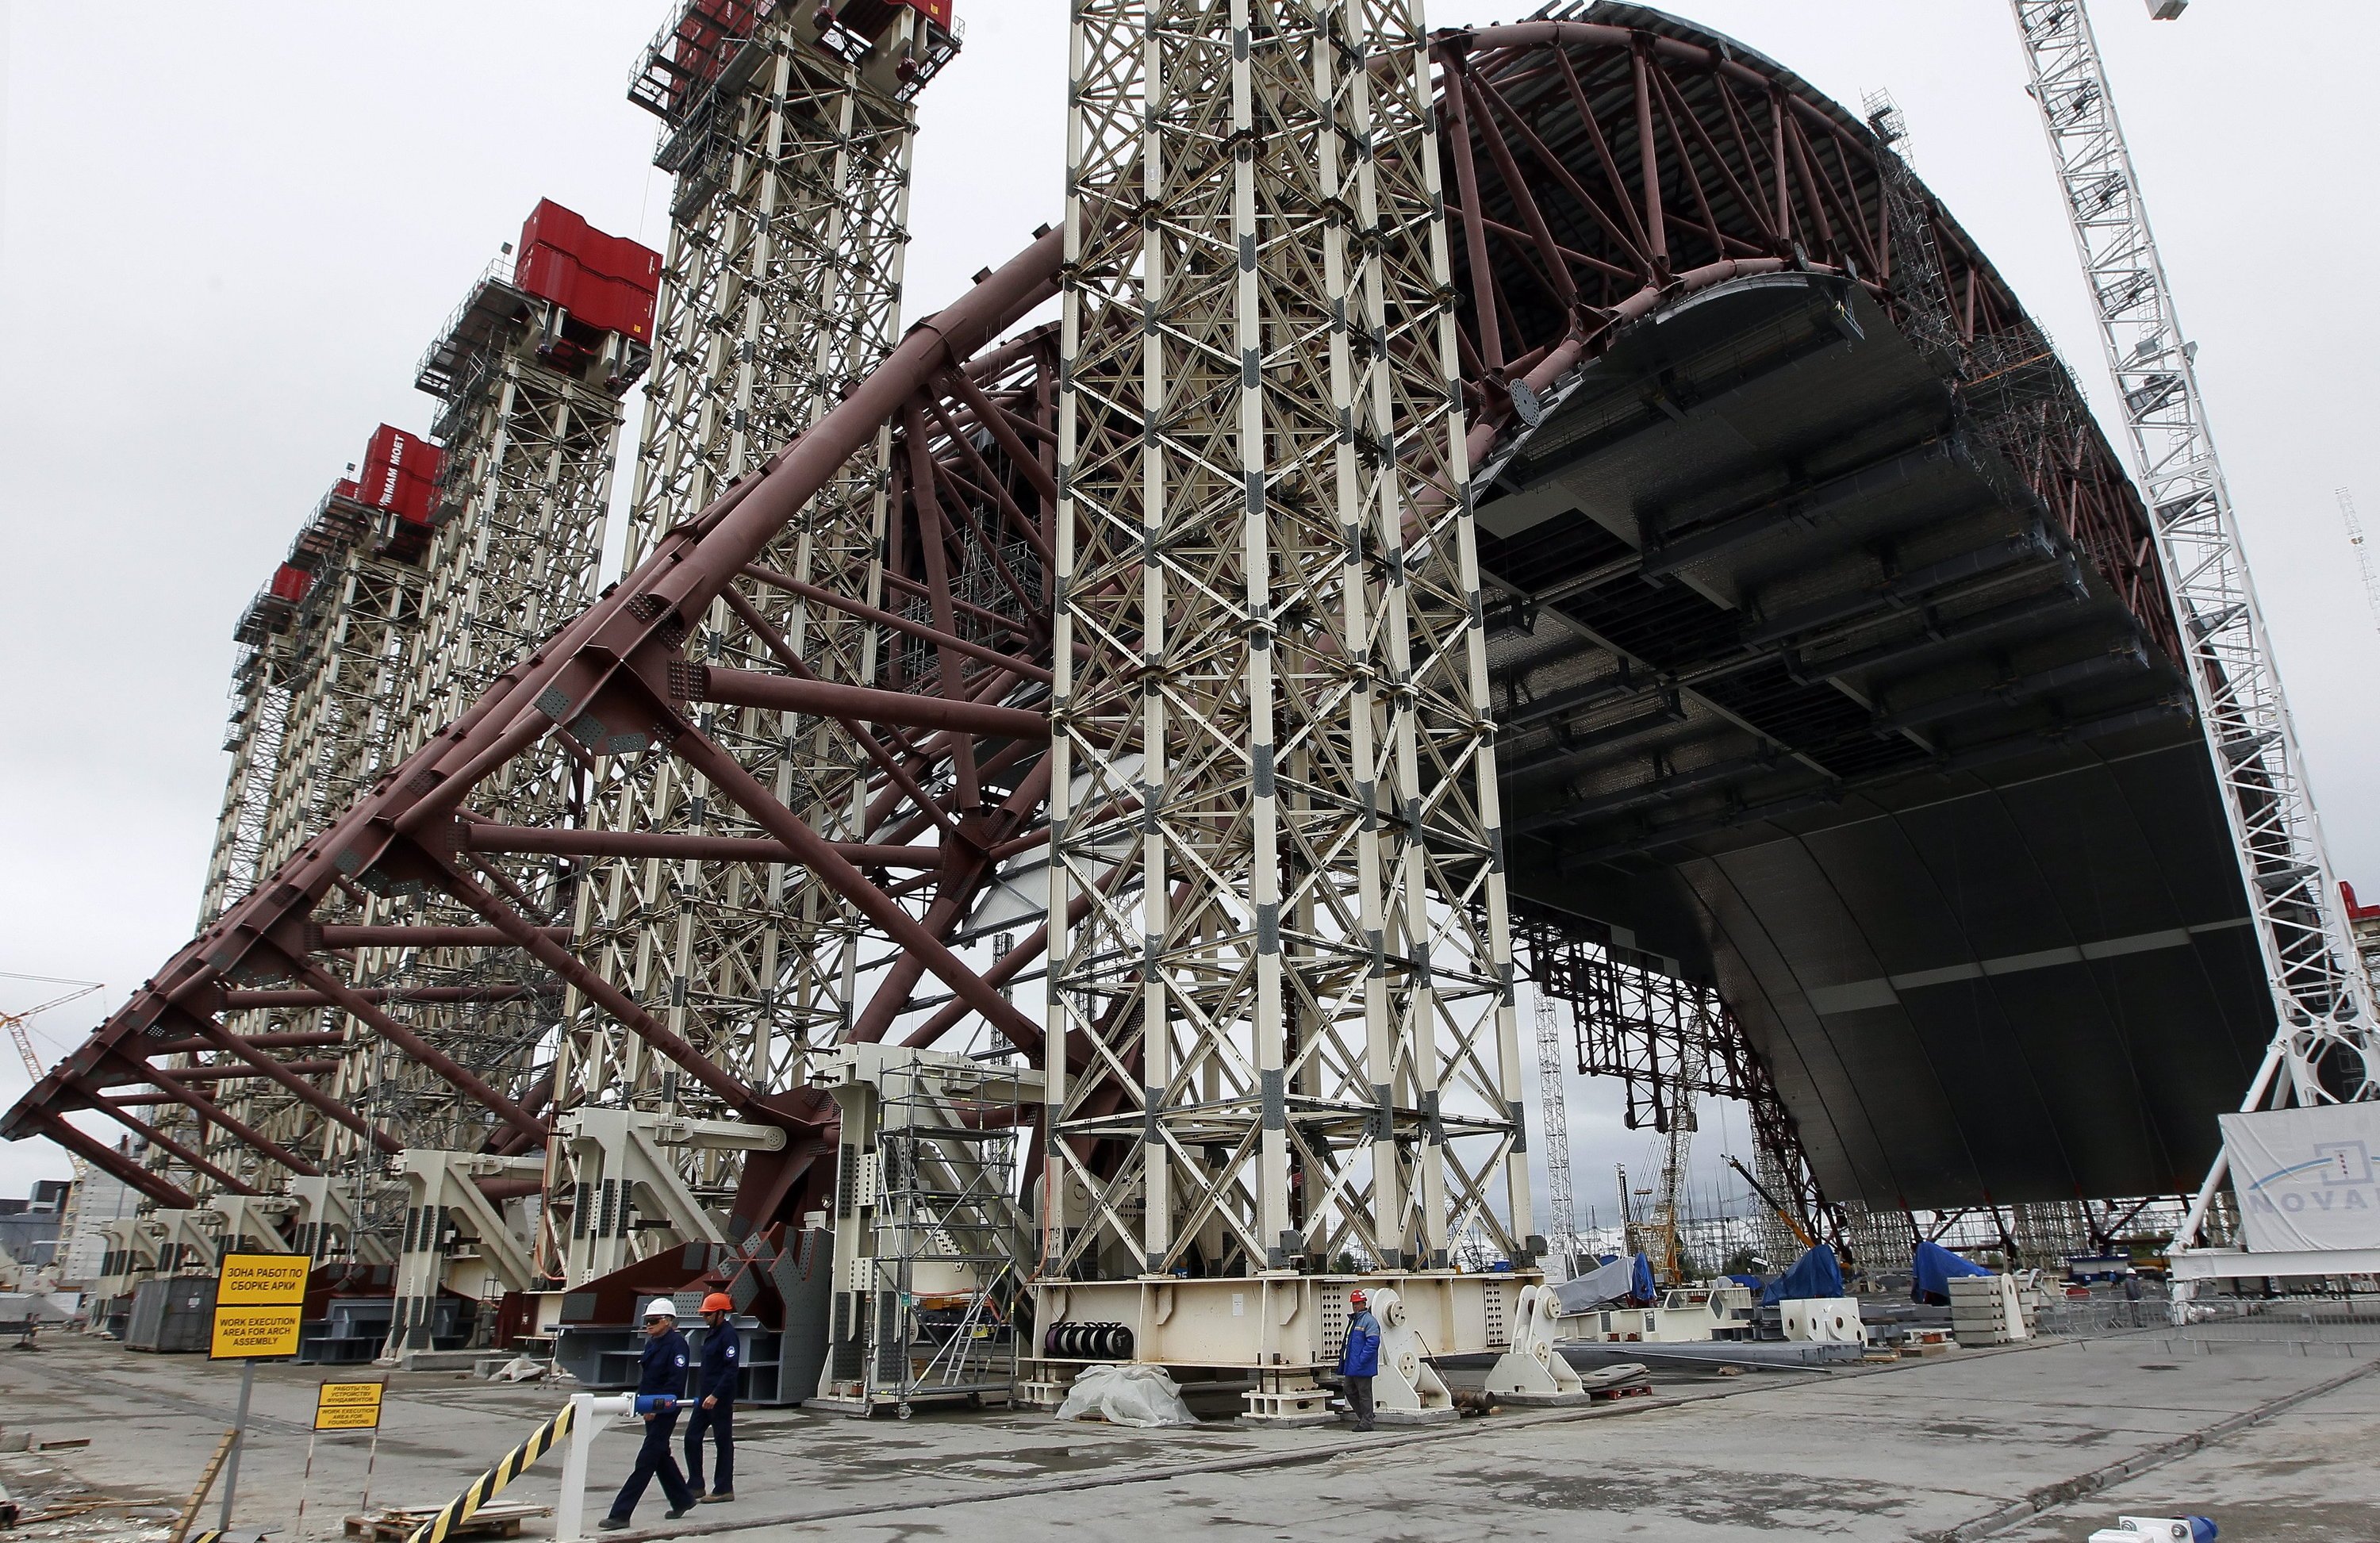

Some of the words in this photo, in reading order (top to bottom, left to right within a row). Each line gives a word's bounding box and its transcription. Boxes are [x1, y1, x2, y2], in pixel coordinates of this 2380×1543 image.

[2248, 1188, 2380, 1213] NOVA
[228, 1268, 254, 1277] ЗОНА
[255, 1268, 288, 1277] РАБОТ
[289, 1269, 302, 1278] ПО
[231, 1281, 270, 1291] СБОРКЕ
[271, 1281, 295, 1291] АРКИ
[248, 1318, 296, 1326] EXECUTION
[232, 1337, 278, 1346] ASSEMBLY
